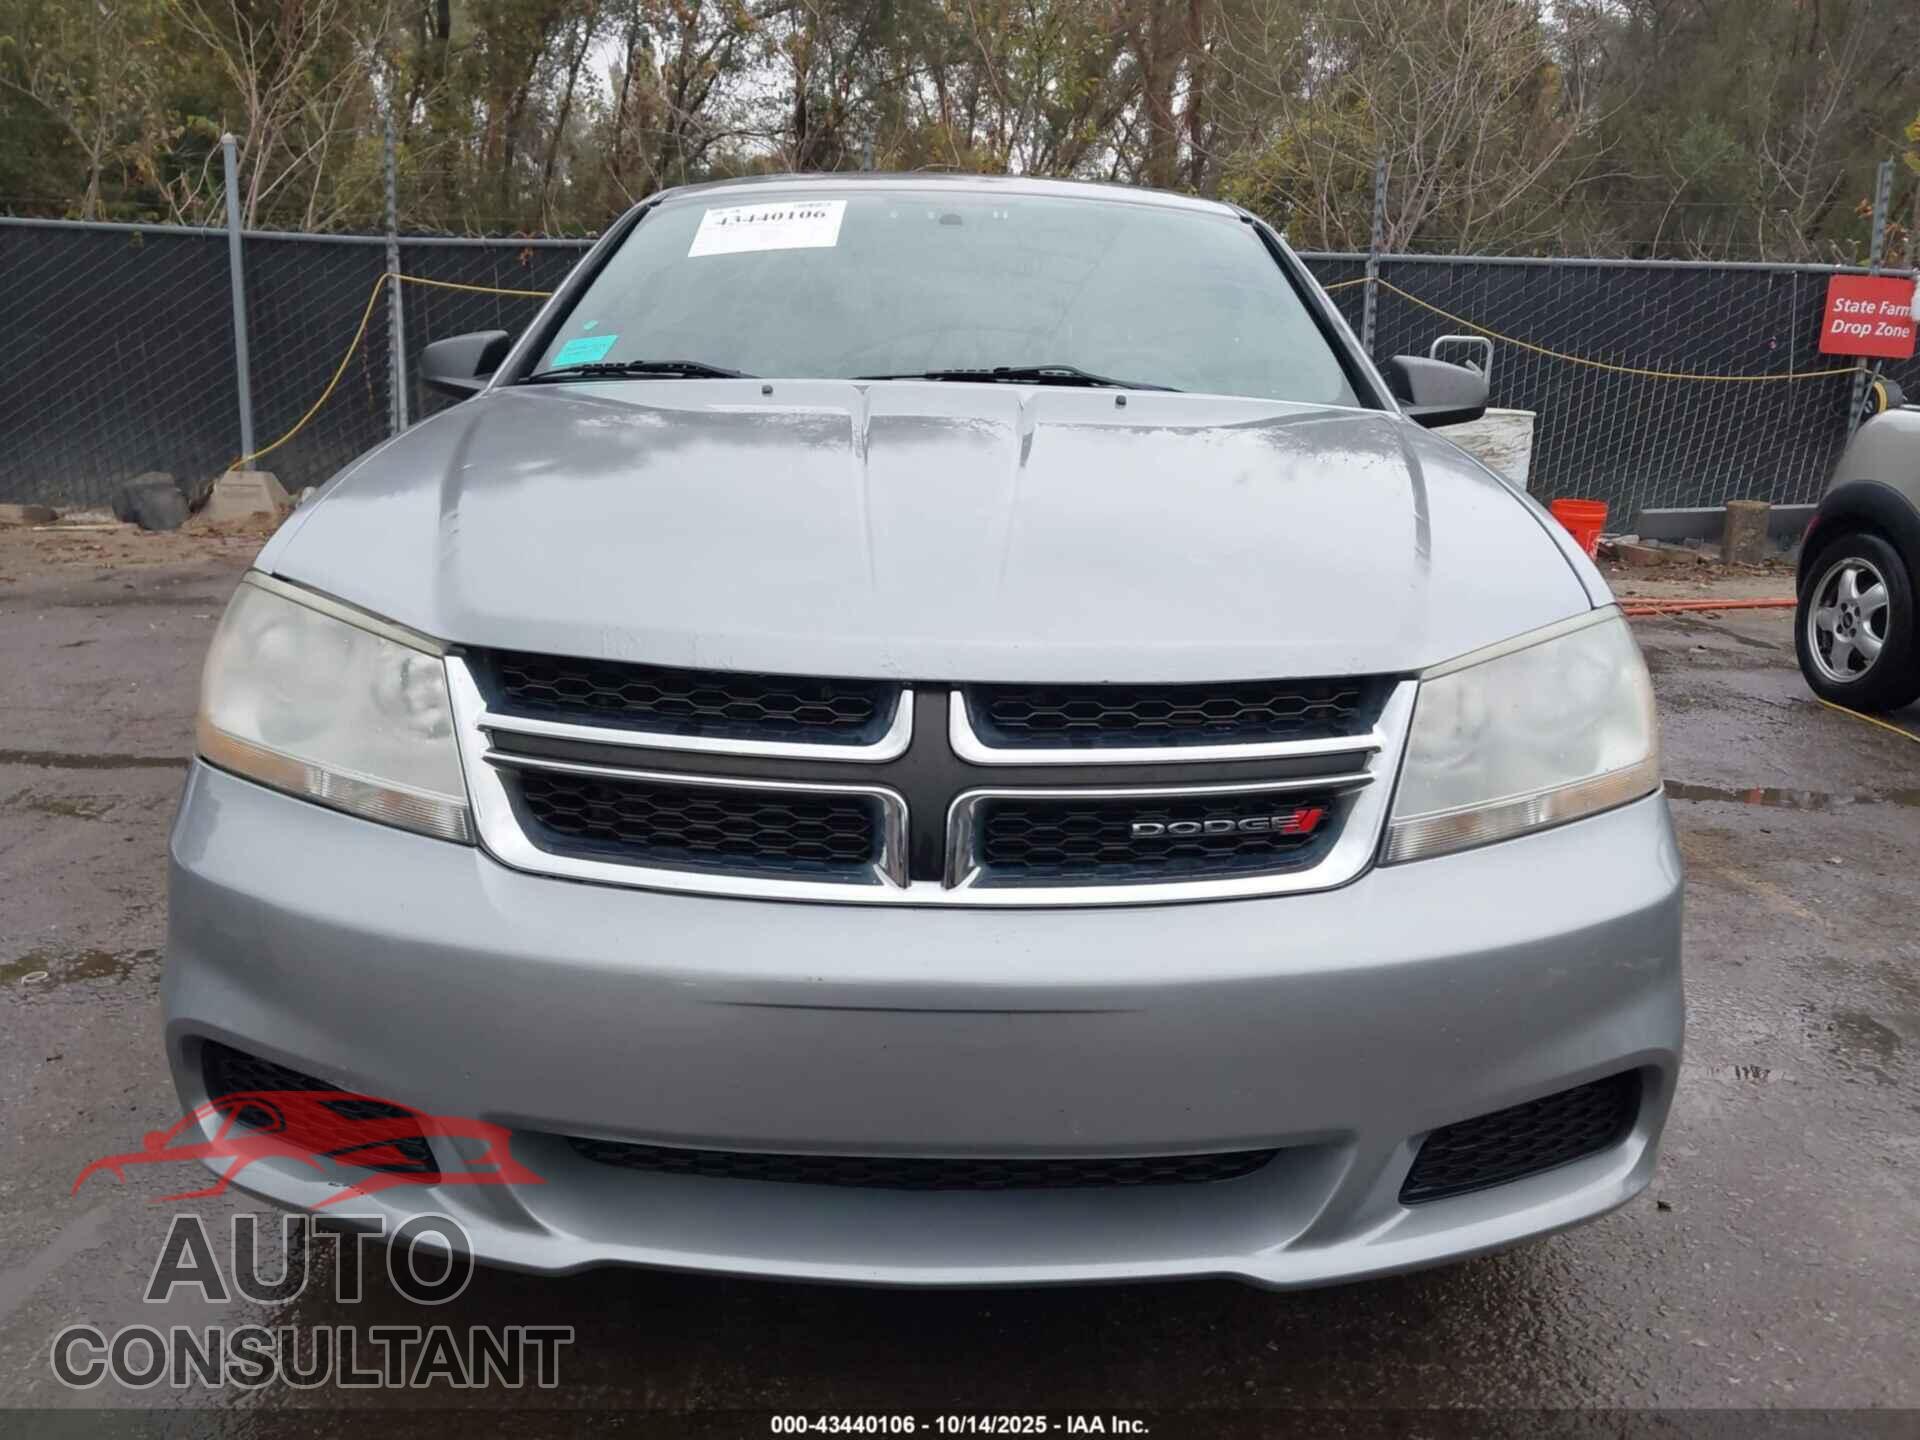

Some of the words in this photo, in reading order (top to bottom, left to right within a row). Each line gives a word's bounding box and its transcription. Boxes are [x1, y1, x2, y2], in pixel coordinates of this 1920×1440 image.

[1833, 298, 1876, 314] State
[1831, 319, 1872, 338] Drop
[1874, 321, 1911, 338] Zone
[1131, 815, 1300, 837] DODGE
